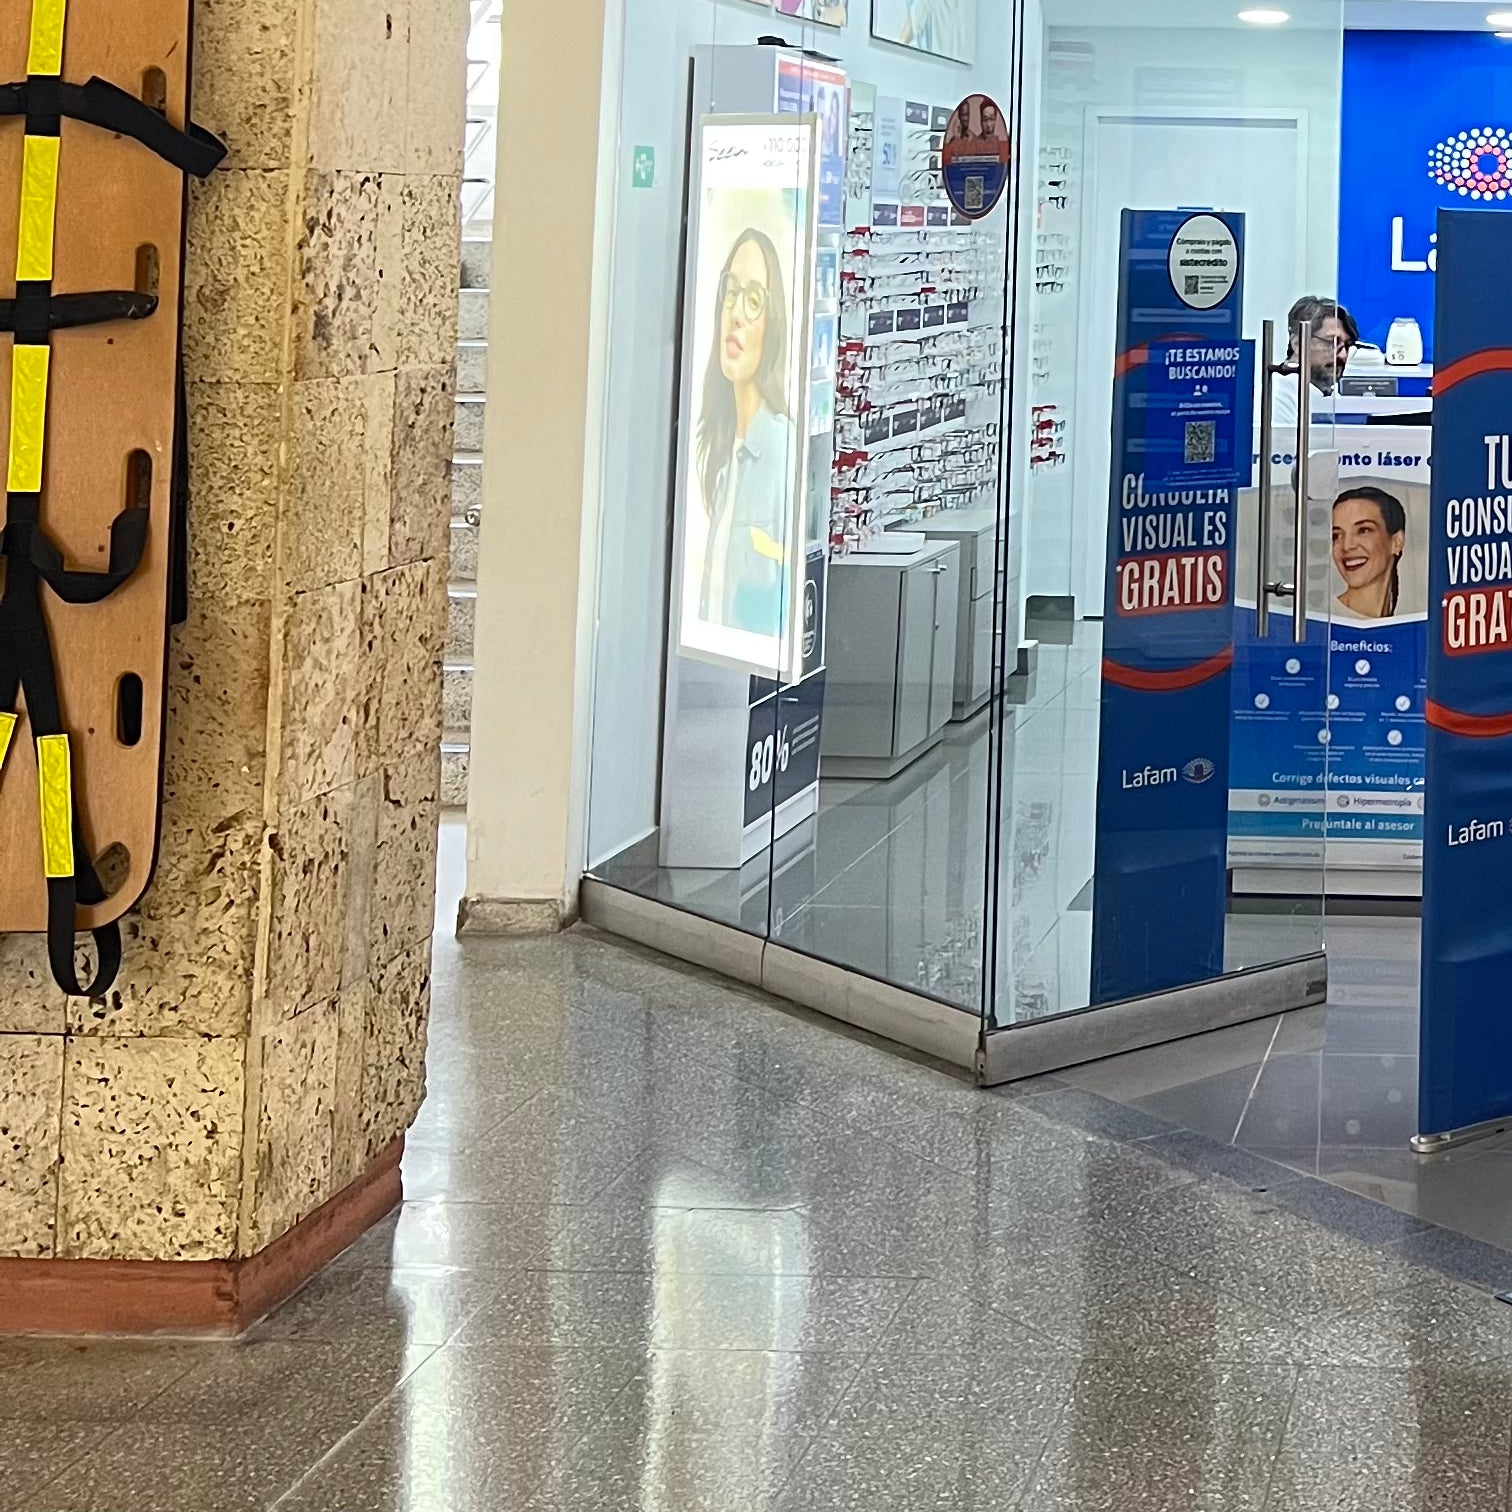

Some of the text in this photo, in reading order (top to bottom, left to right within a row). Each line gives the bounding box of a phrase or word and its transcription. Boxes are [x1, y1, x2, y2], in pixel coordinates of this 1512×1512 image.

[1165, 348, 1240, 366] ¡TE ESTAMOS
[1168, 365, 1236, 380] BUSCANDO!
[1377, 451, 1422, 467] láser
[1122, 511, 1227, 552] VISUAL ES
[1331, 640, 1393, 653] Beneficios:
[1122, 766, 1177, 789] Lafam
[1272, 772, 1313, 786] Corrige
[1365, 773, 1411, 785] visuales
[1364, 819, 1375, 830] al
[1378, 821, 1415, 831] asesor
[1448, 819, 1503, 846] Lafam
